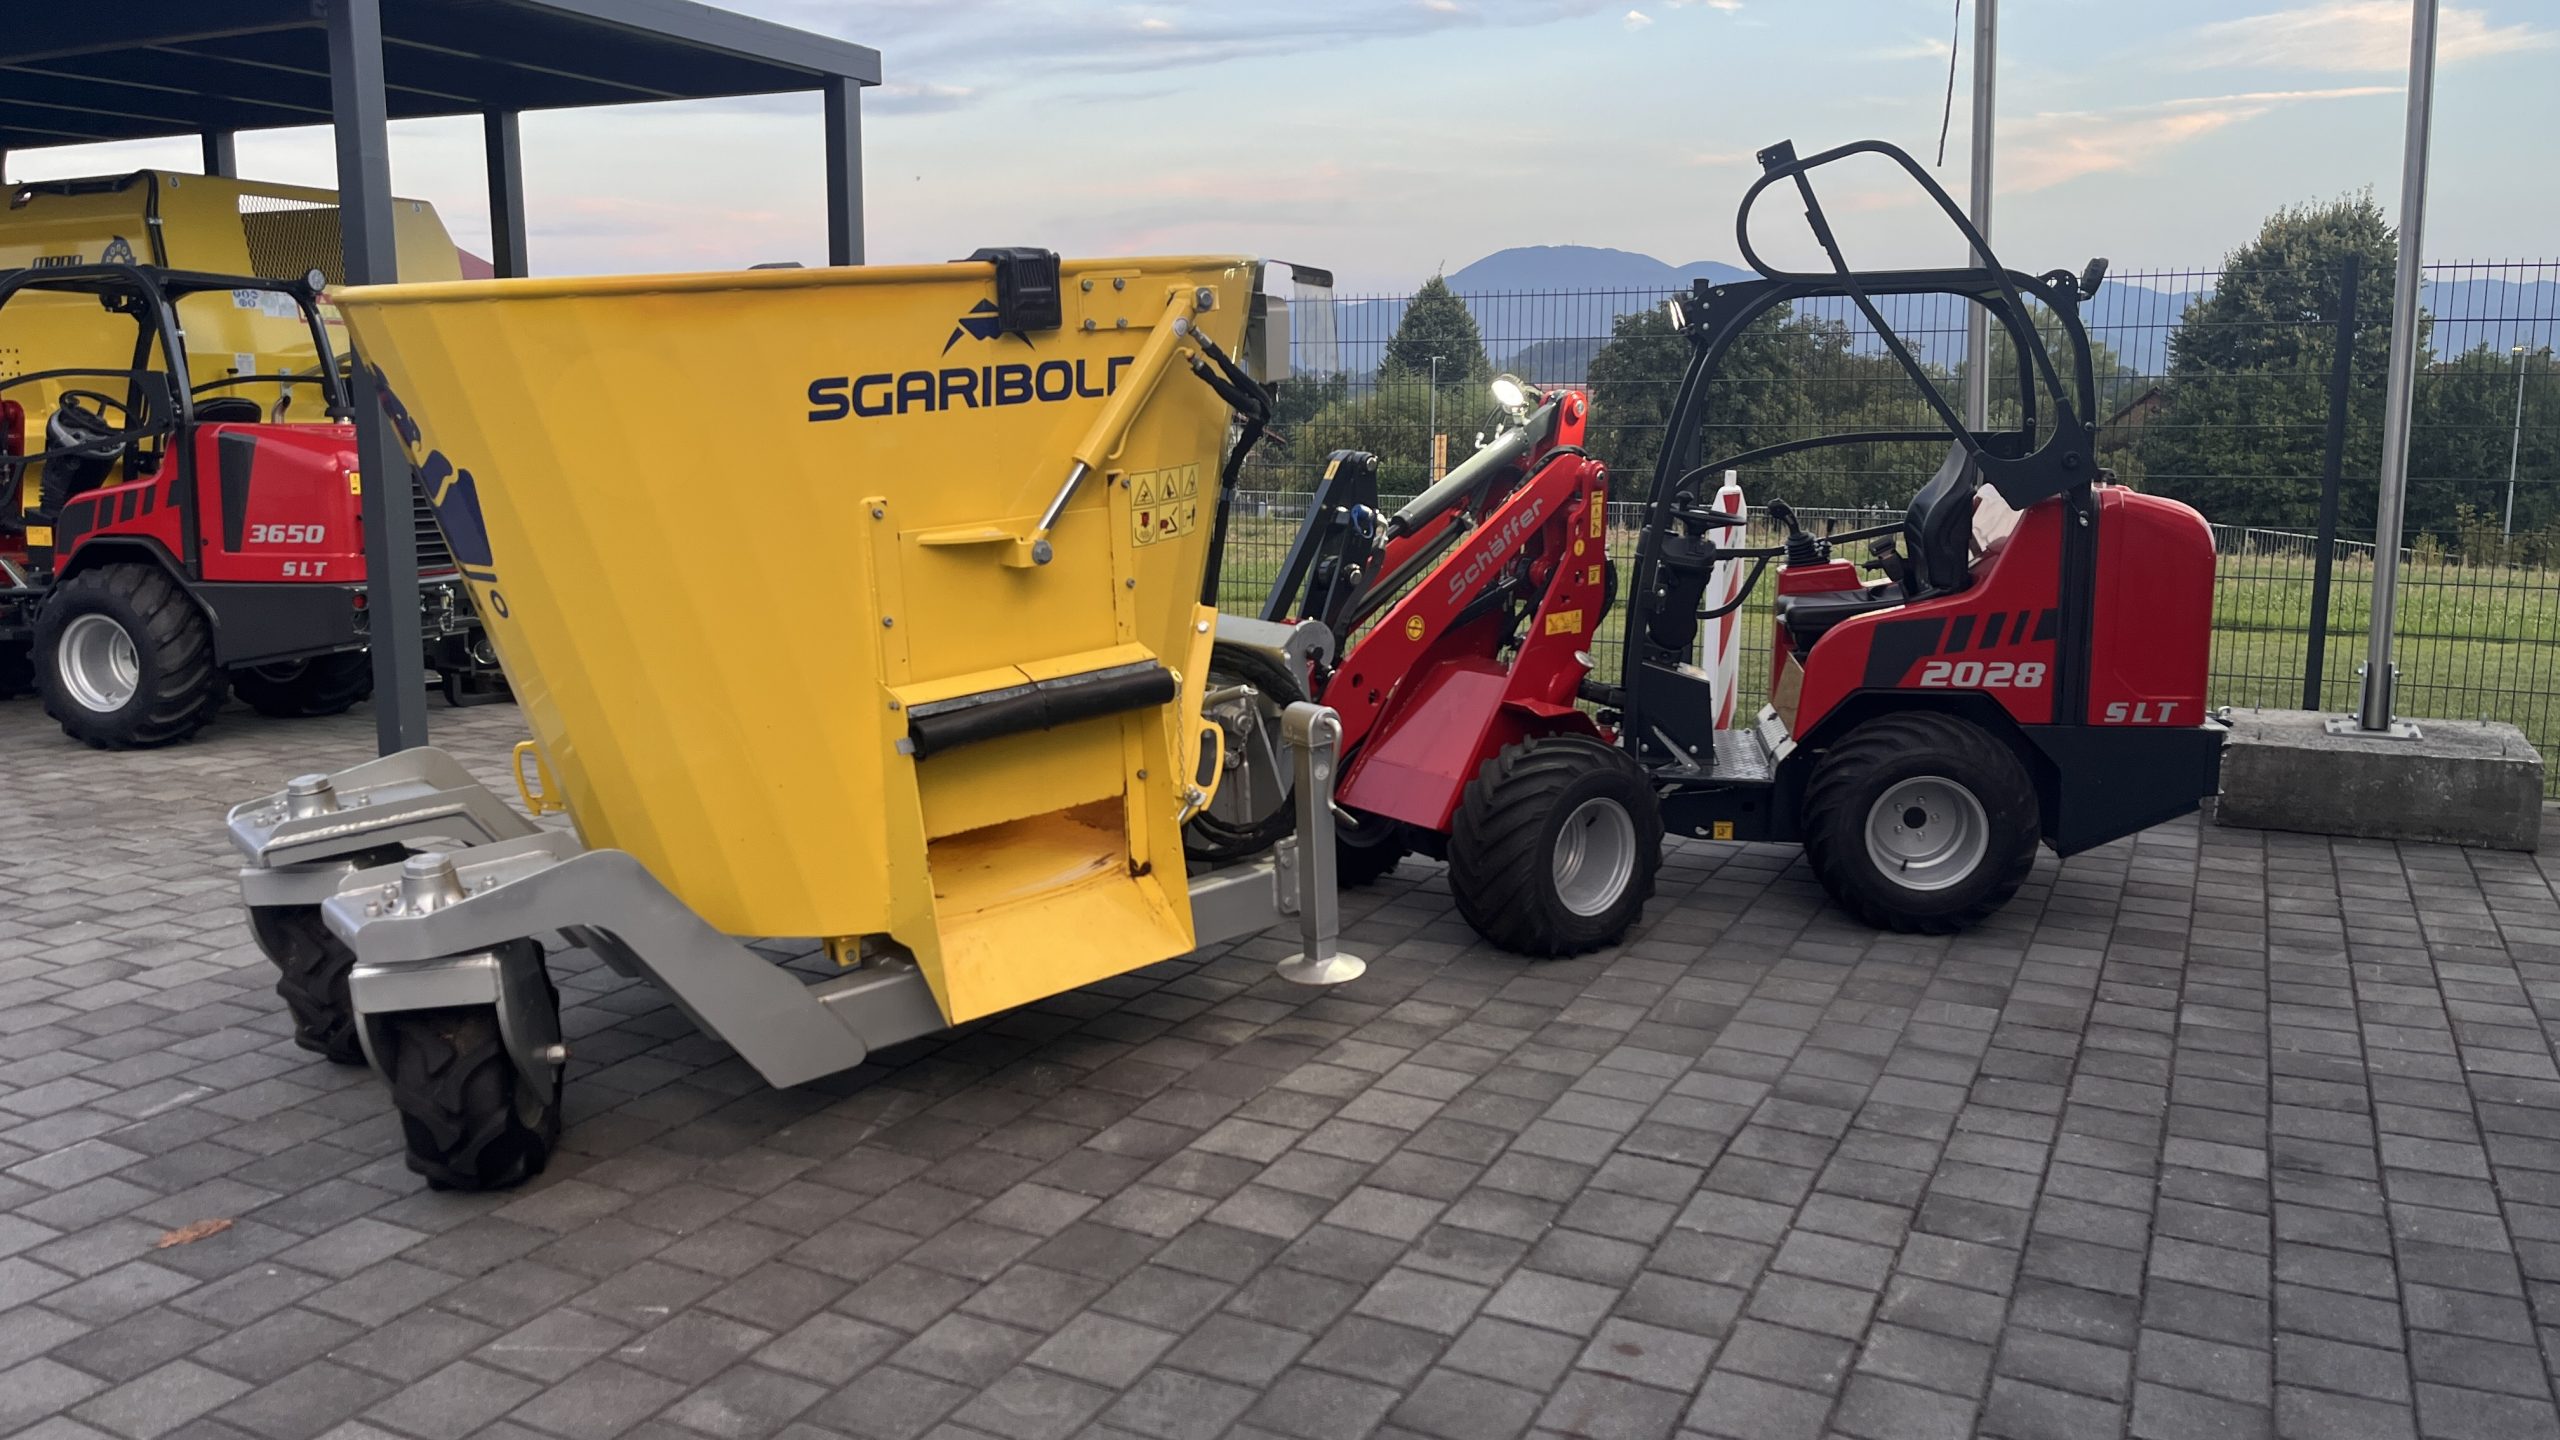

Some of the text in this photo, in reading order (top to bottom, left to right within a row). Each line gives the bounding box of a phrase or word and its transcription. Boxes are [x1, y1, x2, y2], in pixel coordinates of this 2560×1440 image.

[248, 524, 326, 544] 3650
[1447, 498, 1544, 606] Schäffer
[281, 561, 328, 577] SLT
[1919, 661, 2047, 688] 2028
[2103, 702, 2179, 723] SLT
